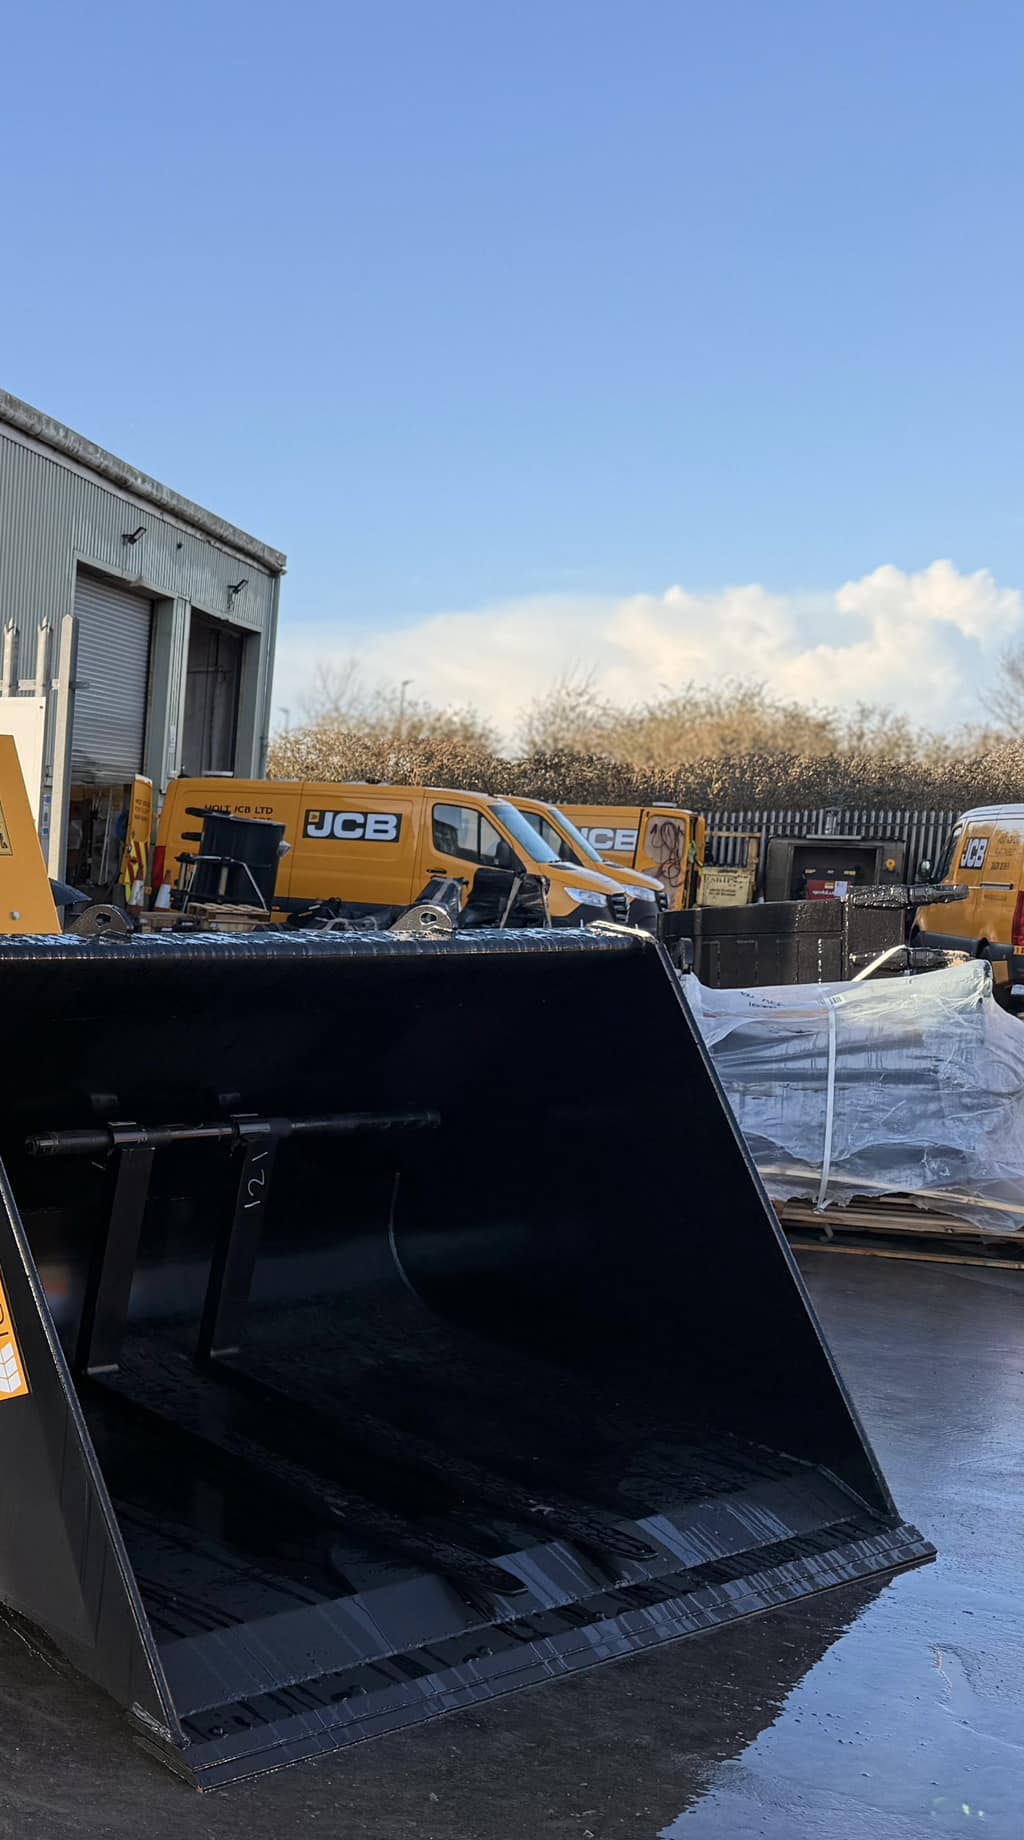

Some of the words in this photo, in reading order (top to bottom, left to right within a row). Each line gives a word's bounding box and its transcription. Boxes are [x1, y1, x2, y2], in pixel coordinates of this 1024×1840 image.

[255, 806, 273, 814] LTD
[307, 811, 397, 840] JCB
[961, 838, 988, 867] JCB
